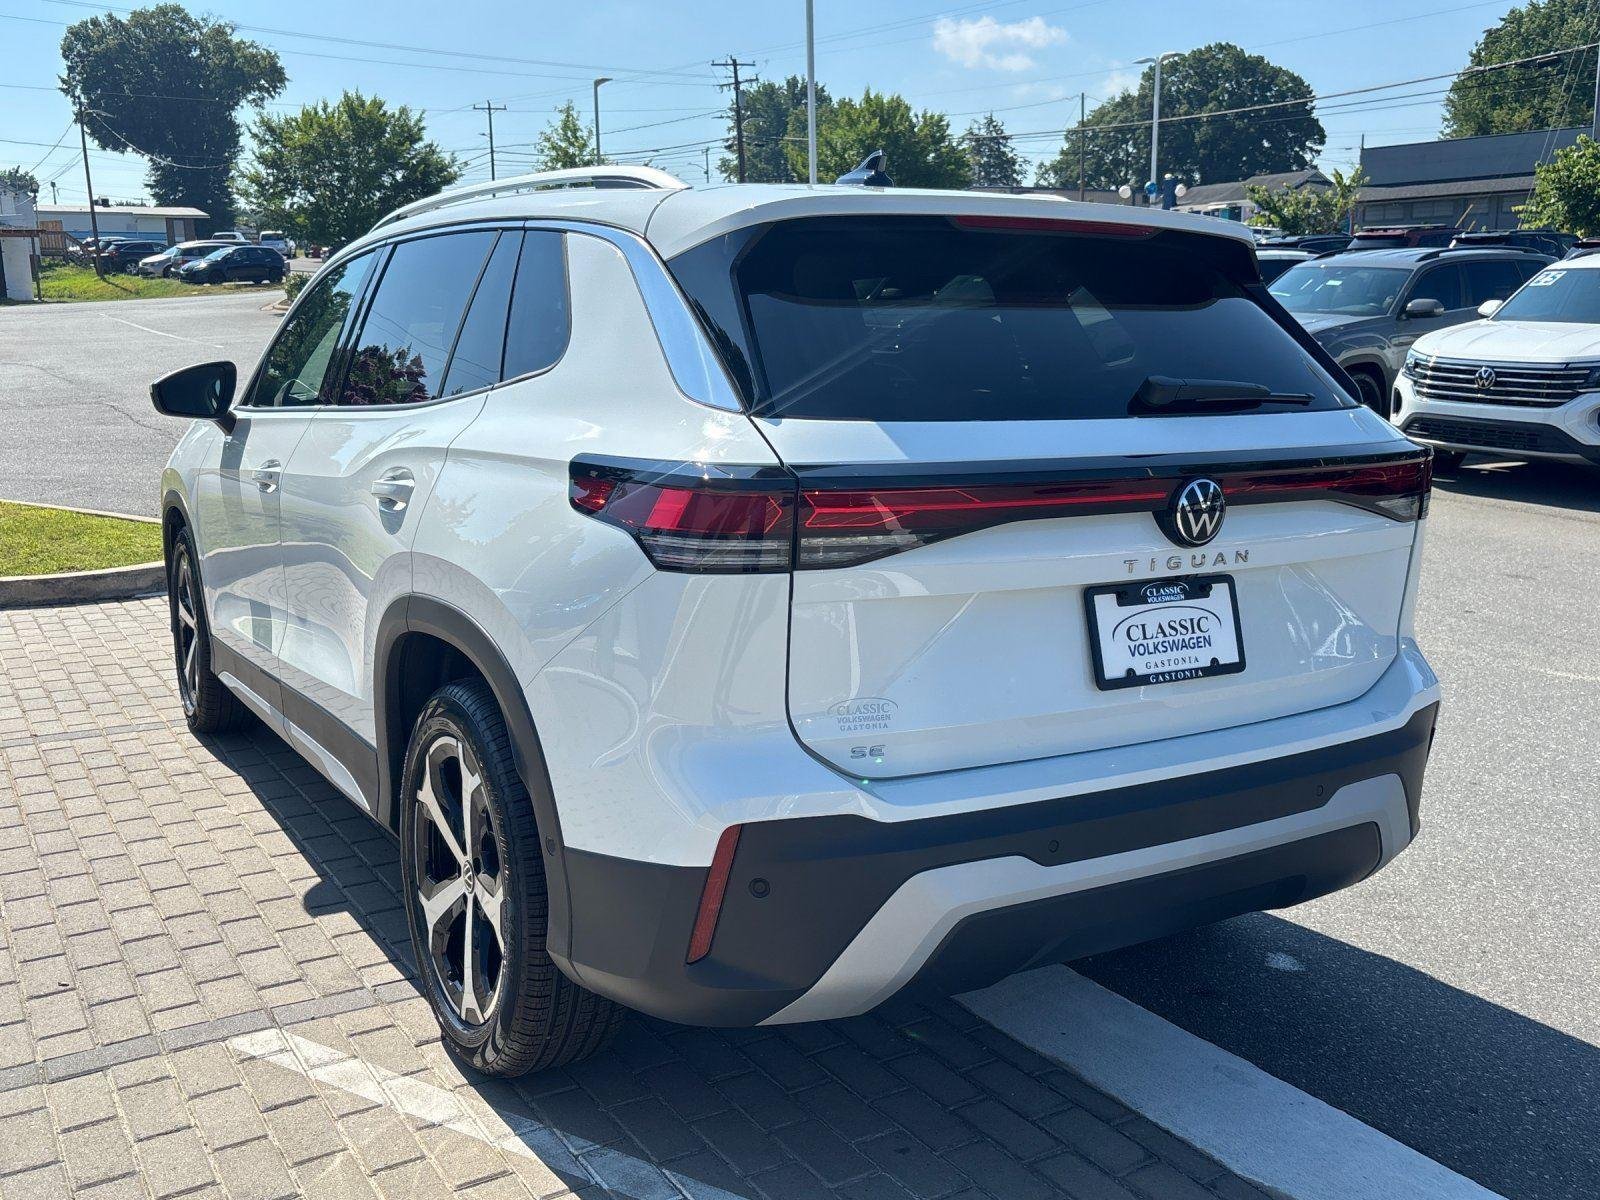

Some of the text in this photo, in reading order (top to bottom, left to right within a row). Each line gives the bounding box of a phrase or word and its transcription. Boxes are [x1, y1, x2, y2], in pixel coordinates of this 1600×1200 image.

[1176, 478, 1226, 544] VW
[1123, 549, 1250, 574] TIGUAN
[1146, 585, 1184, 597] CLASSIC
[1147, 593, 1185, 604] VOLKSWAGEN
[1126, 616, 1210, 642] CLASSIC
[1128, 635, 1212, 657] VOLKSWAGEN
[1145, 656, 1200, 670] GASTONIA
[1149, 669, 1203, 683] GASTONIA
[836, 702, 890, 716] CLASSIC
[836, 713, 891, 724] VOLKSWAGEN
[840, 722, 889, 732] GASTONIA
[850, 744, 887, 760] SE
